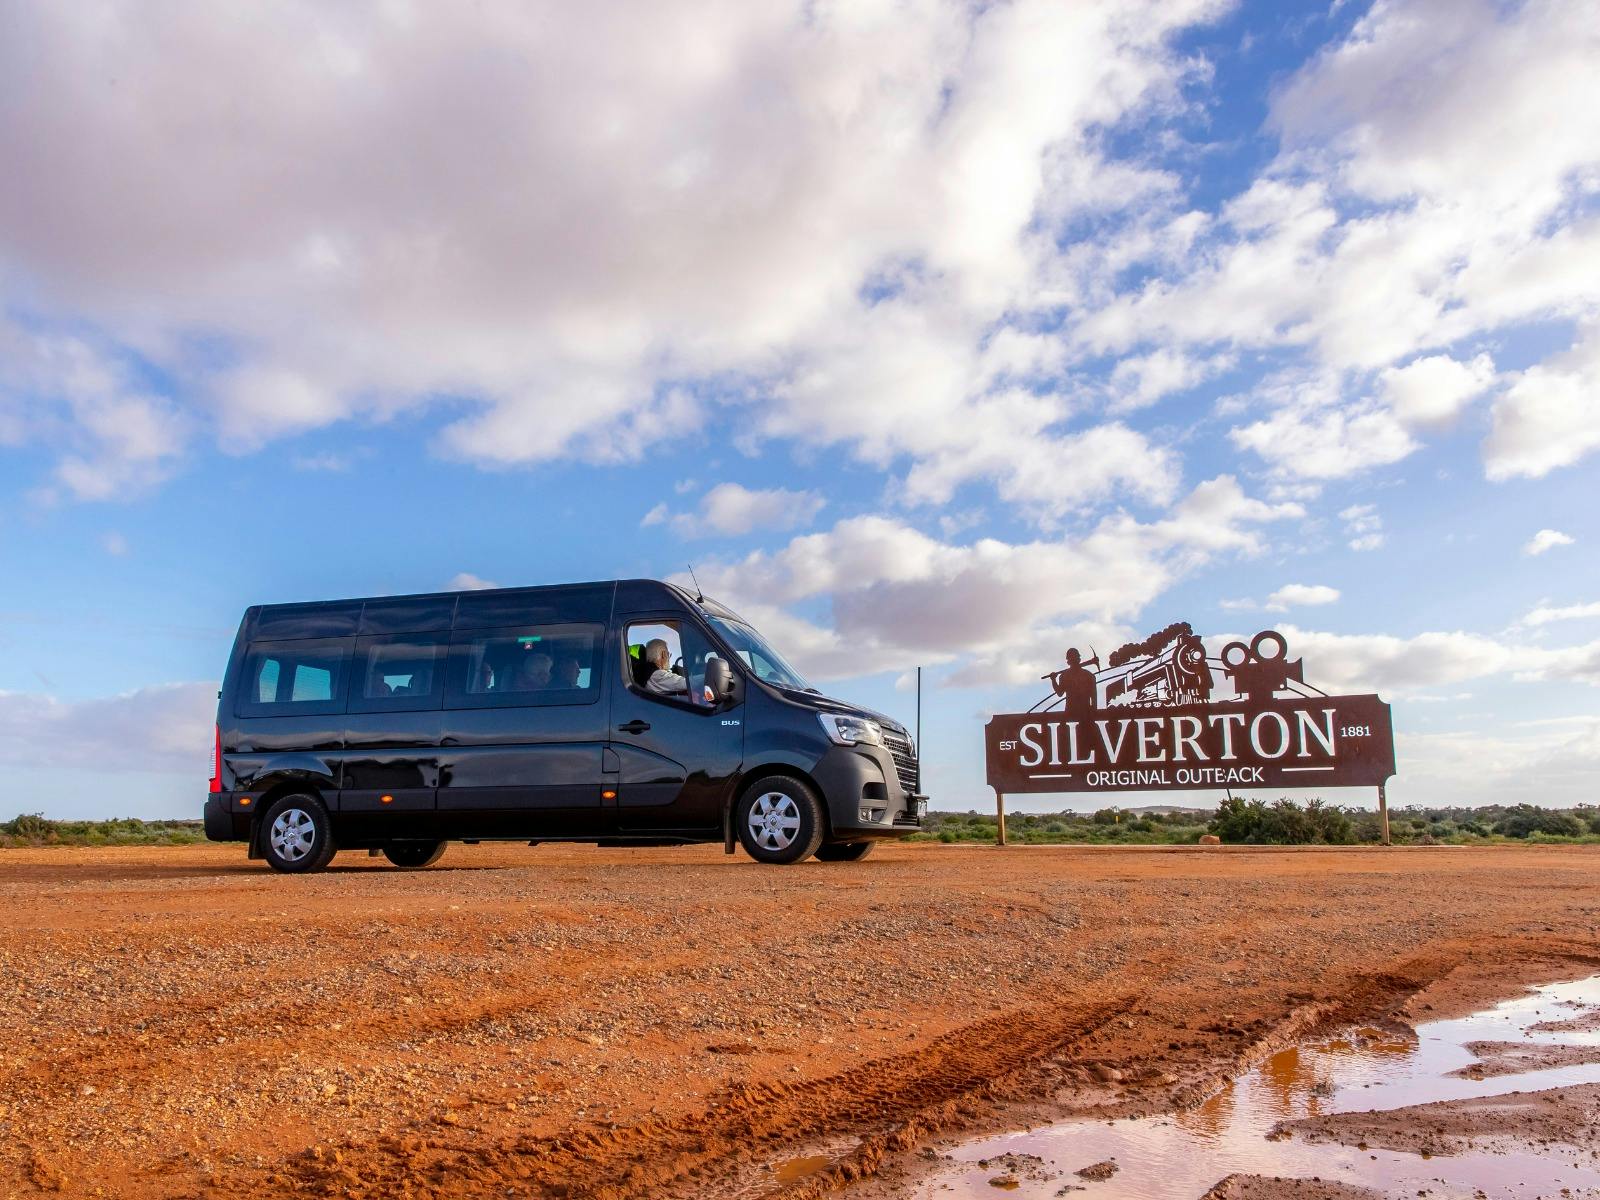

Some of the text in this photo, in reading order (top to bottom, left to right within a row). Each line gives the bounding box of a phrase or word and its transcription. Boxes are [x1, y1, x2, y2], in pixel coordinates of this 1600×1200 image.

[999, 708, 1372, 767] EST SILVERTON 1881
[1086, 766, 1265, 786] ORIGINAL OUTBACK
